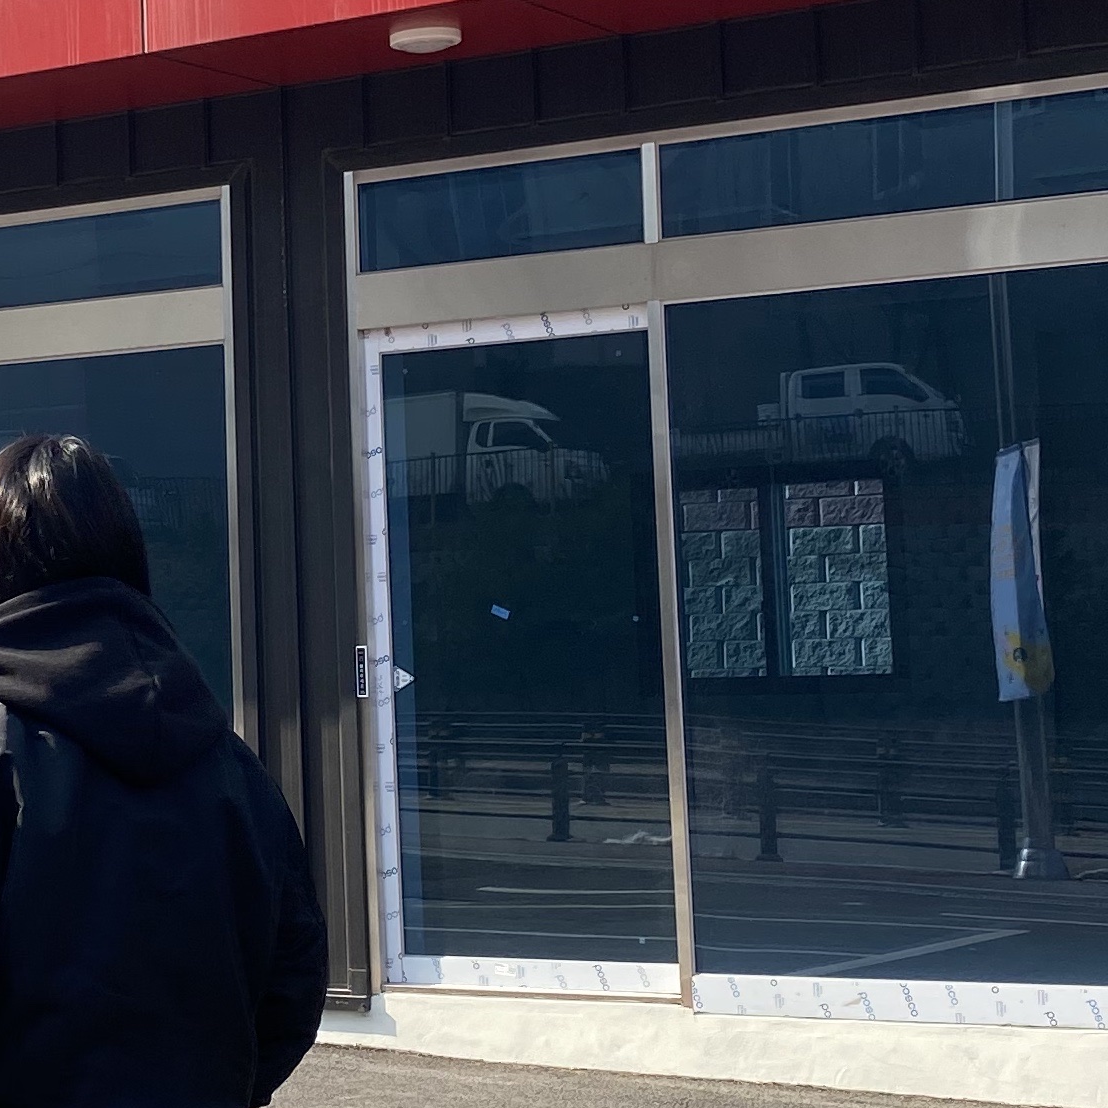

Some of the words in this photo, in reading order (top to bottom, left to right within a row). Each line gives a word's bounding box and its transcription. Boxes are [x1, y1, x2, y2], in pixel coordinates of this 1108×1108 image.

[592, 964, 610, 991] posc
[727, 977, 741, 998] sco
[692, 981, 703, 1008] osco
[857, 992, 876, 1021] posc
[945, 985, 959, 1006] sco
[1085, 999, 1105, 1029] posc
